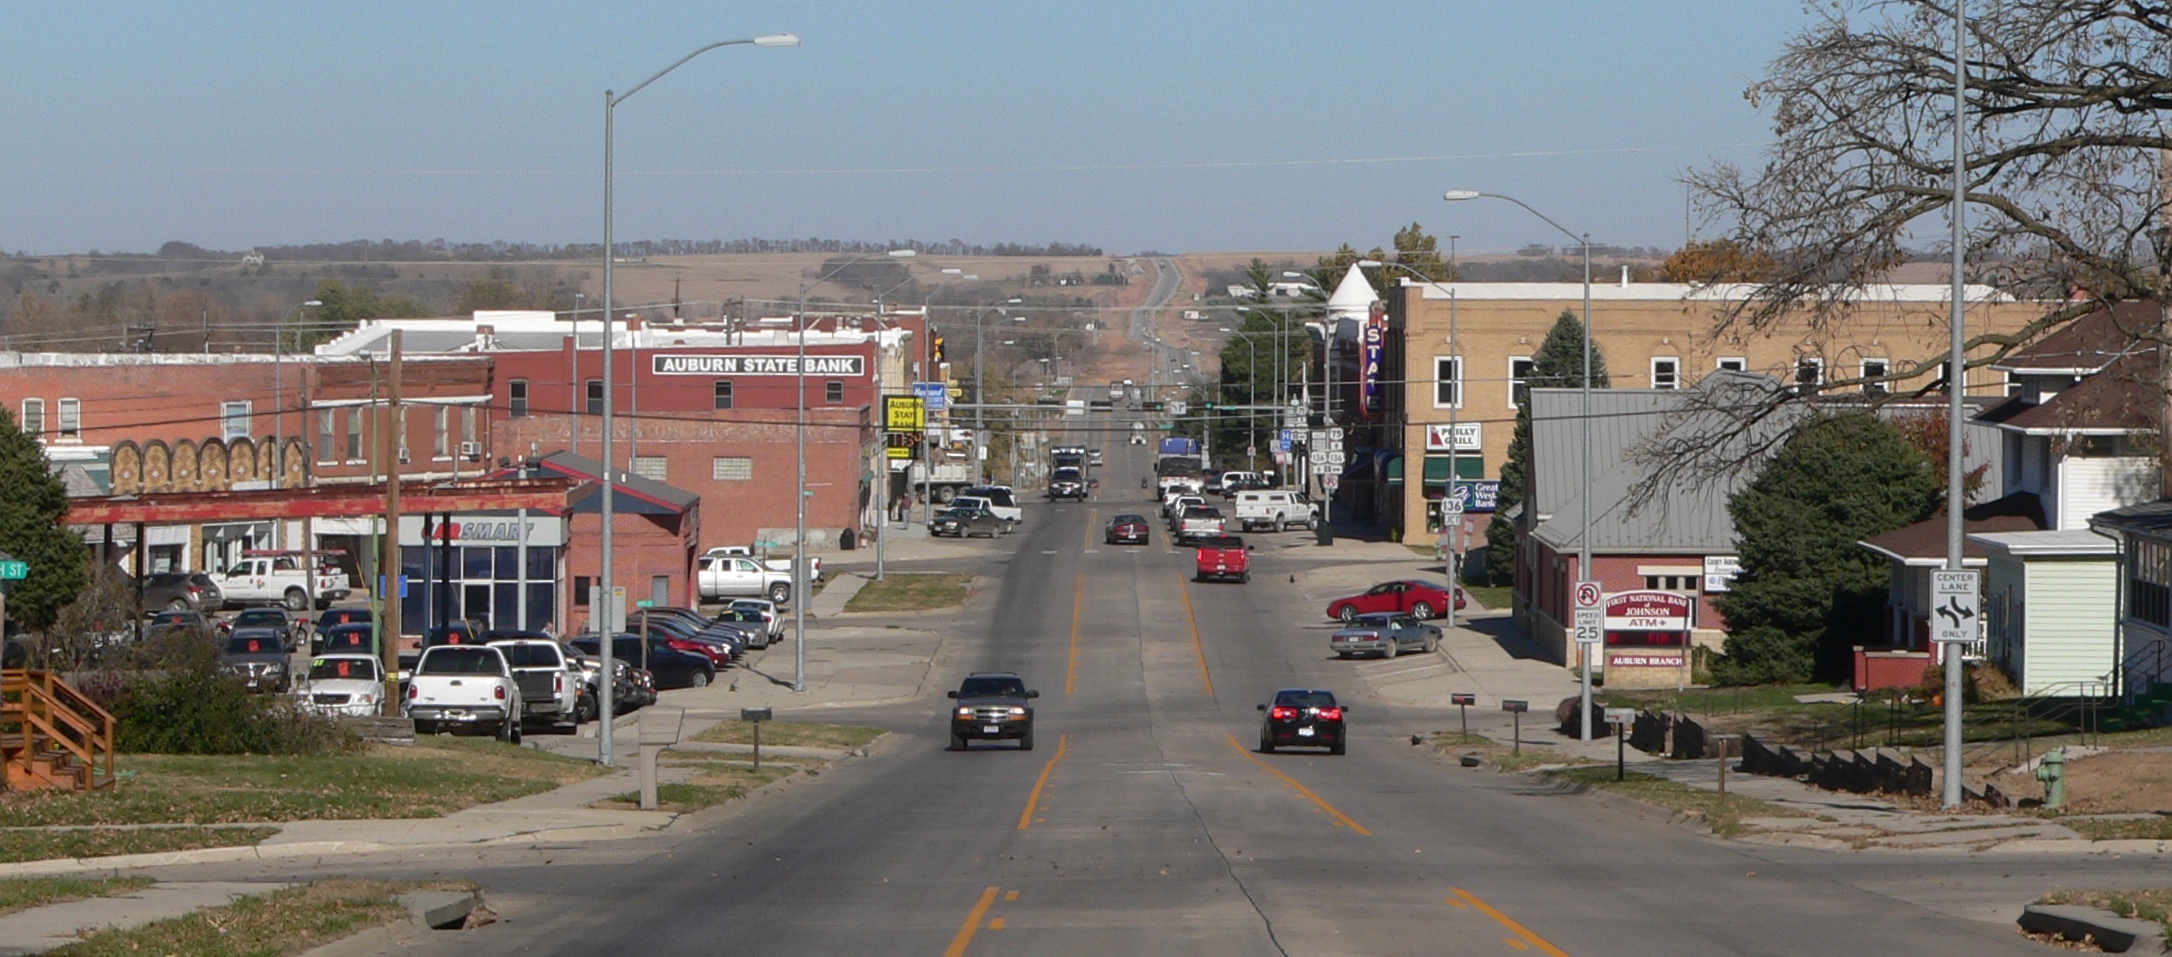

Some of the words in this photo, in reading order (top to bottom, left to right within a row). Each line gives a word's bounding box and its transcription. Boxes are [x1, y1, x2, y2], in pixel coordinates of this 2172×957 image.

[663, 358, 737, 372] AUBURN
[743, 358, 797, 373] STATE
[804, 358, 854, 373] BANK
[1282, 431, 1290, 440] H
[1332, 430, 1342, 438] 75
[1475, 483, 1498, 492] Great
[1443, 501, 1461, 511] 136
[1475, 500, 1496, 508] Bank
[1446, 516, 1459, 524] JCT
[10, 563, 22, 577] ST
[1606, 596, 1627, 608] FIRST
[1629, 595, 1666, 603] NATIONAL
[1625, 608, 1670, 616] JOHNSON
[1629, 619, 1657, 627] ATM
[1577, 626, 1599, 639] 25
[1613, 657, 1647, 665] AUBURN
[1649, 657, 1683, 665] BRANCH
